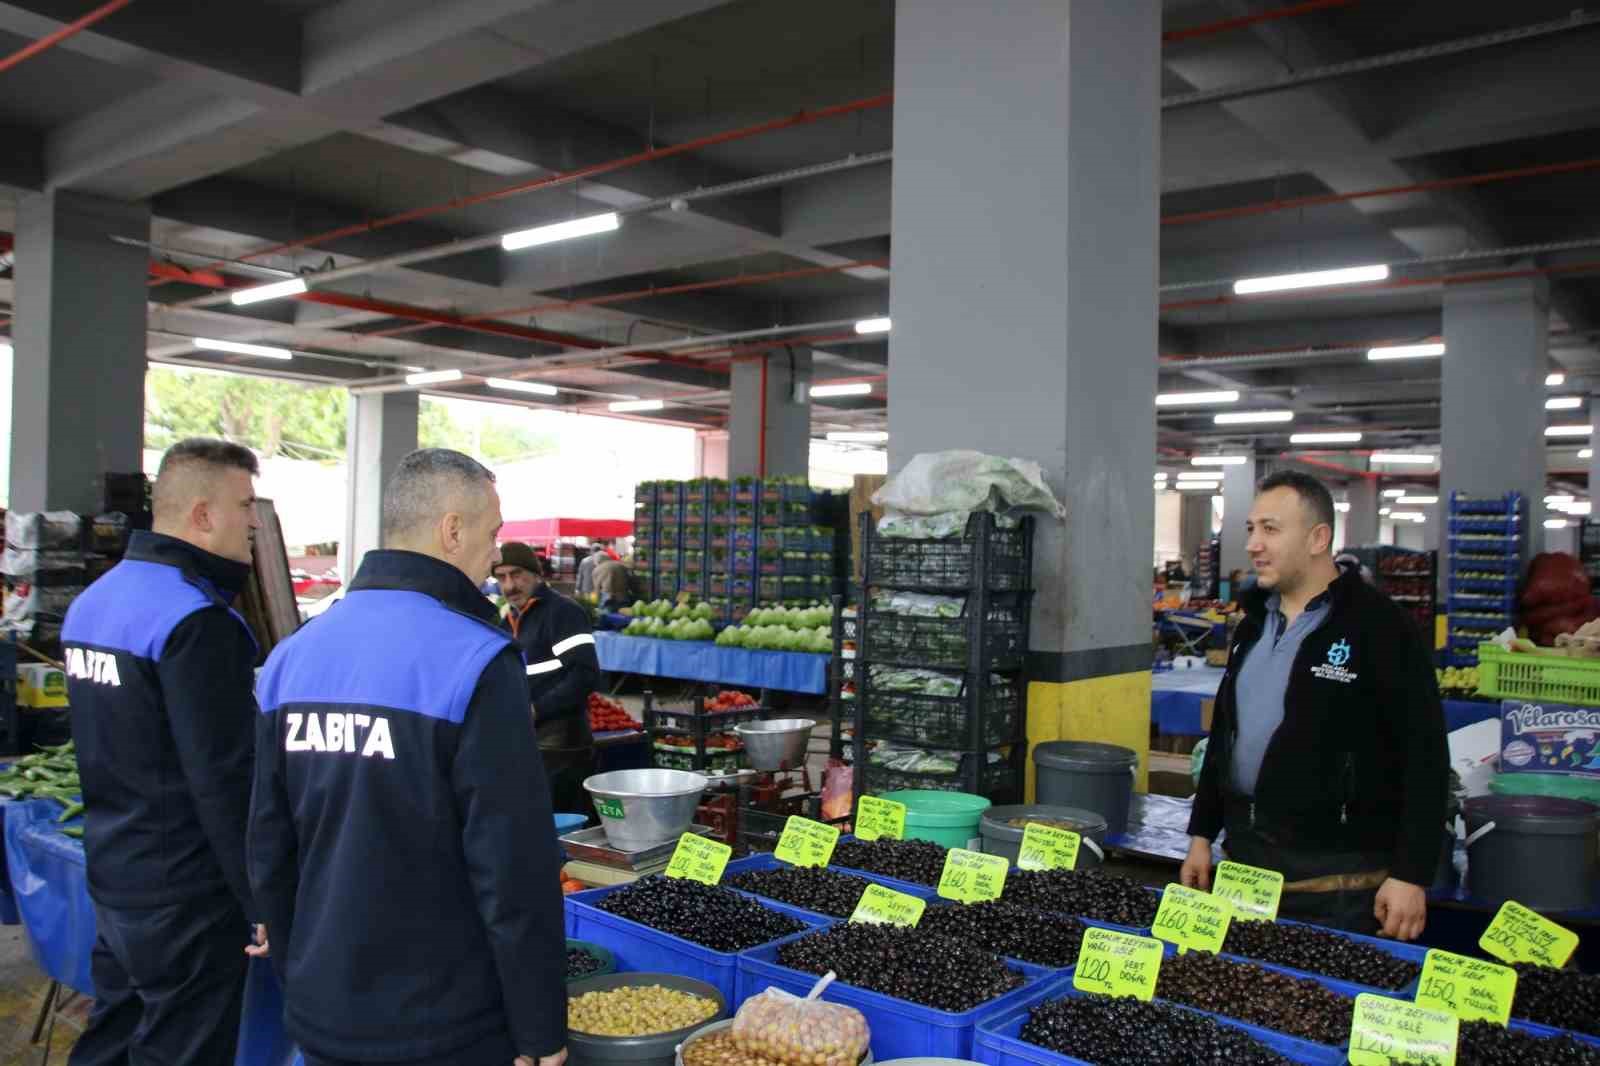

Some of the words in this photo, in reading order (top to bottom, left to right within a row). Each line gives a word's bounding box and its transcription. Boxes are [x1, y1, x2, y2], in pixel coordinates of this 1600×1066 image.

[285, 713, 395, 759] ZABITA
[1155, 908, 1188, 929] 160
[1487, 927, 1517, 948] 200
[1076, 957, 1111, 982] 120
[1420, 976, 1456, 1002] 150
[1352, 1030, 1393, 1055] 120
